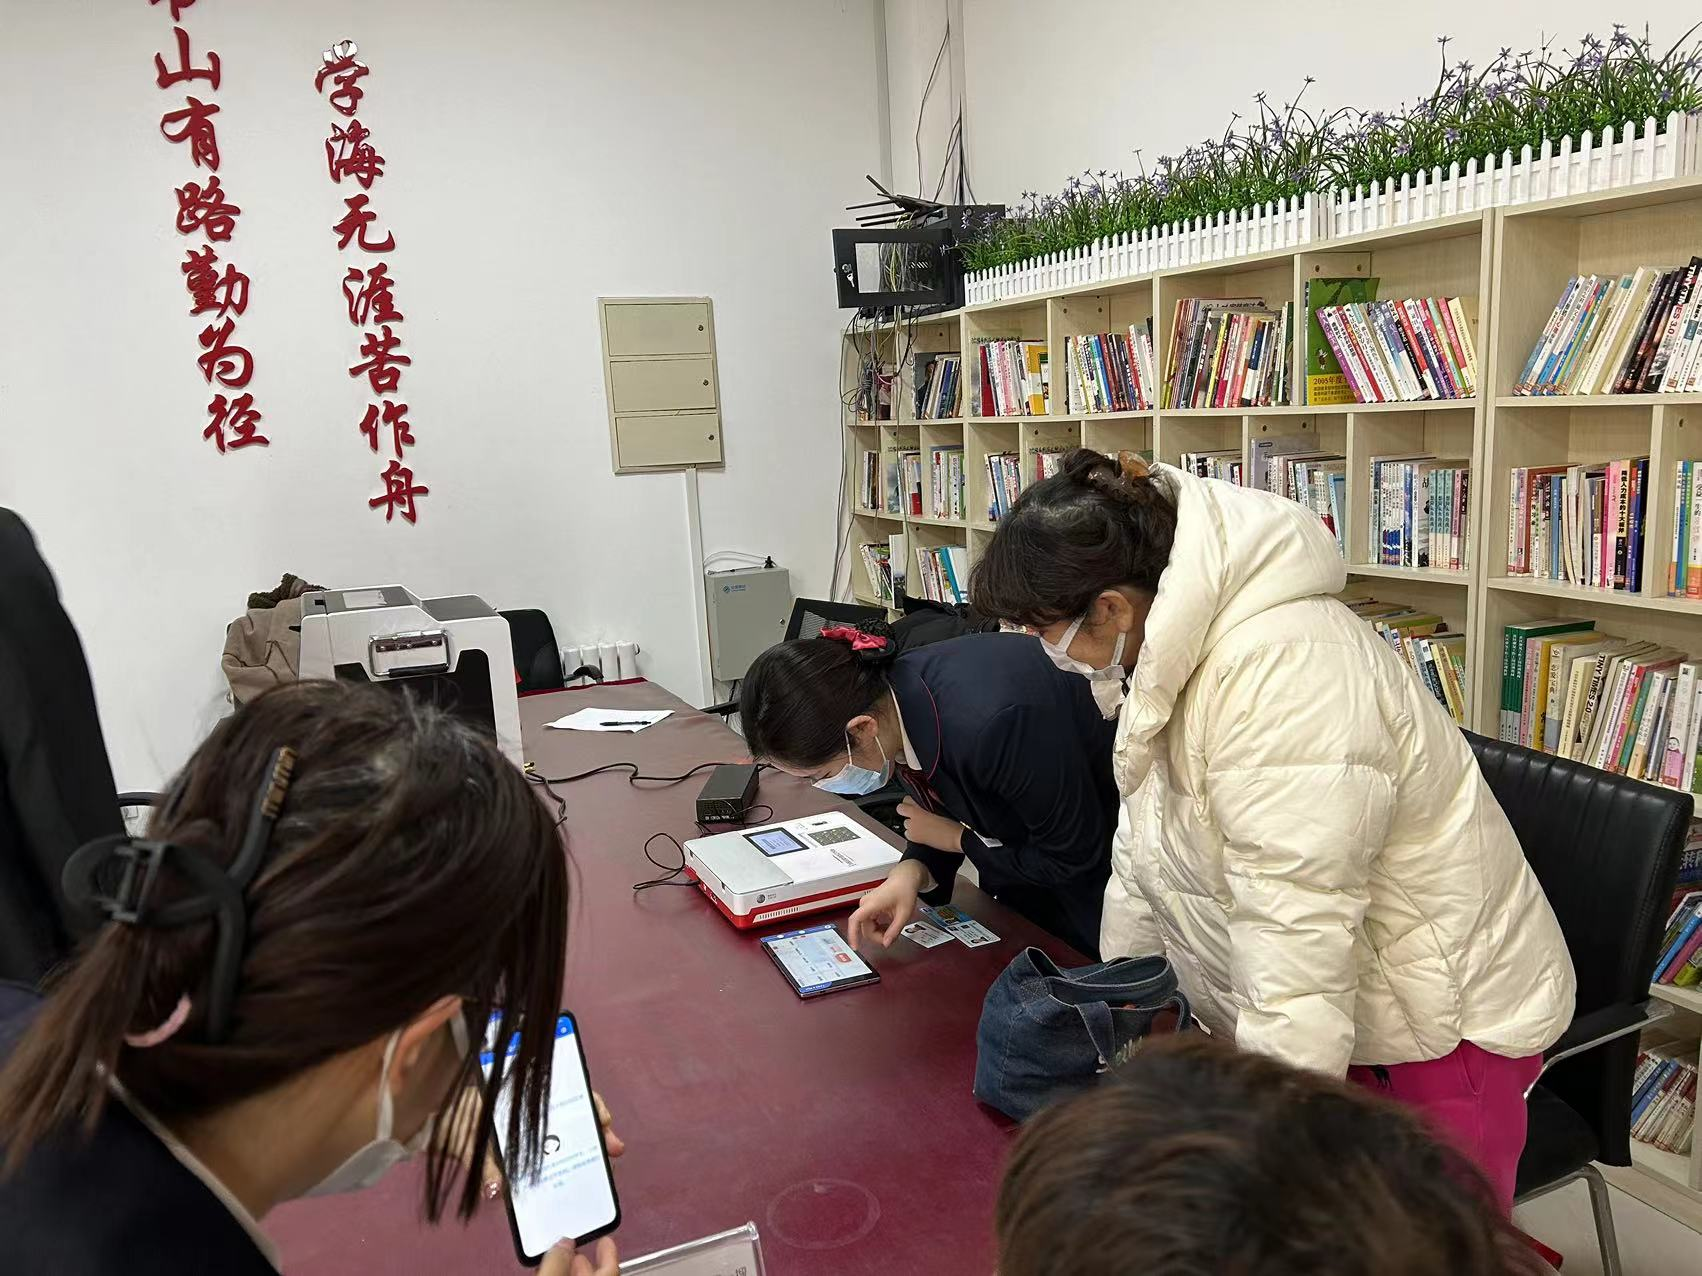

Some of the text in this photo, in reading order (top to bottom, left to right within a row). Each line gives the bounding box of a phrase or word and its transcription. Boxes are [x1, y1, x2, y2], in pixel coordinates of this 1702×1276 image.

[314, 40, 428, 523] 学海无涯苦作舟
[1667, 264, 1697, 335] TINY TIMES 3.0
[1585, 655, 1606, 713] TINY TIMES 2.0
